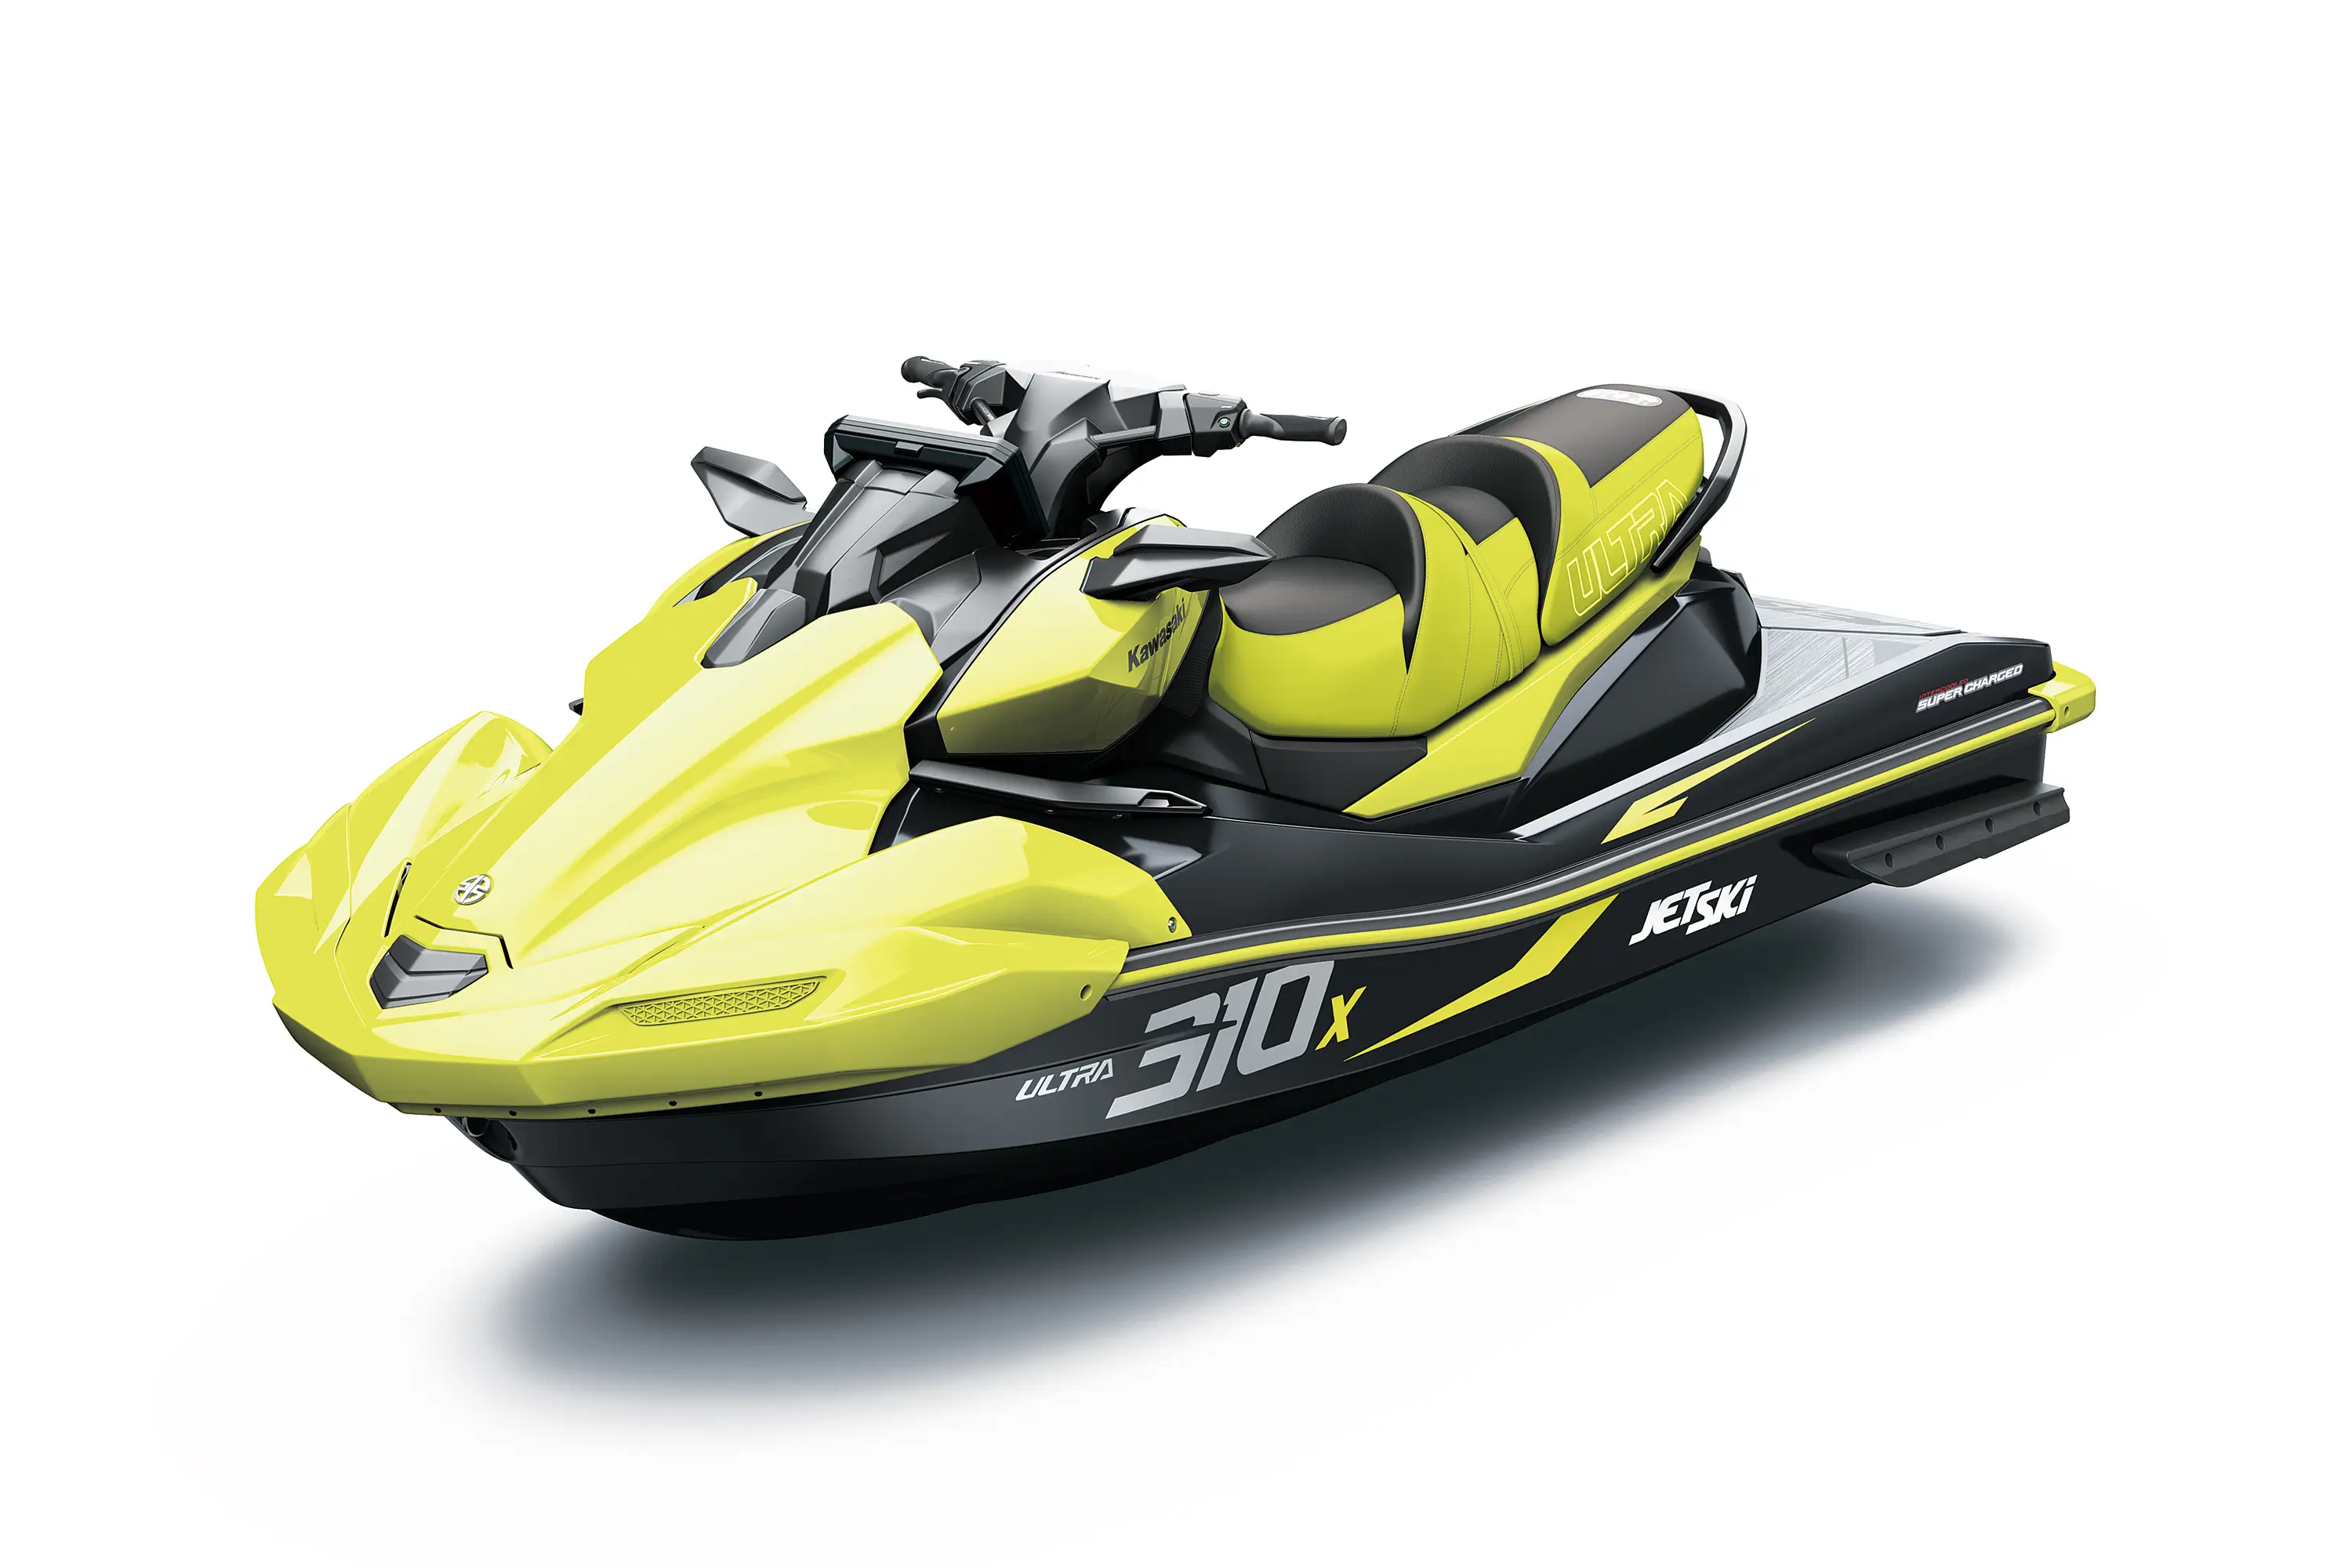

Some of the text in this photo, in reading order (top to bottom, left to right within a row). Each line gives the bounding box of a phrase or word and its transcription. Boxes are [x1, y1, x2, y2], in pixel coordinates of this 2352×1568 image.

[1566, 478, 1688, 617] ULTRA
[1127, 597, 1185, 673] Kawasaki
[1915, 662, 2024, 713] SUPER CHARGED
[1015, 1058, 1114, 1102] ULTRA
